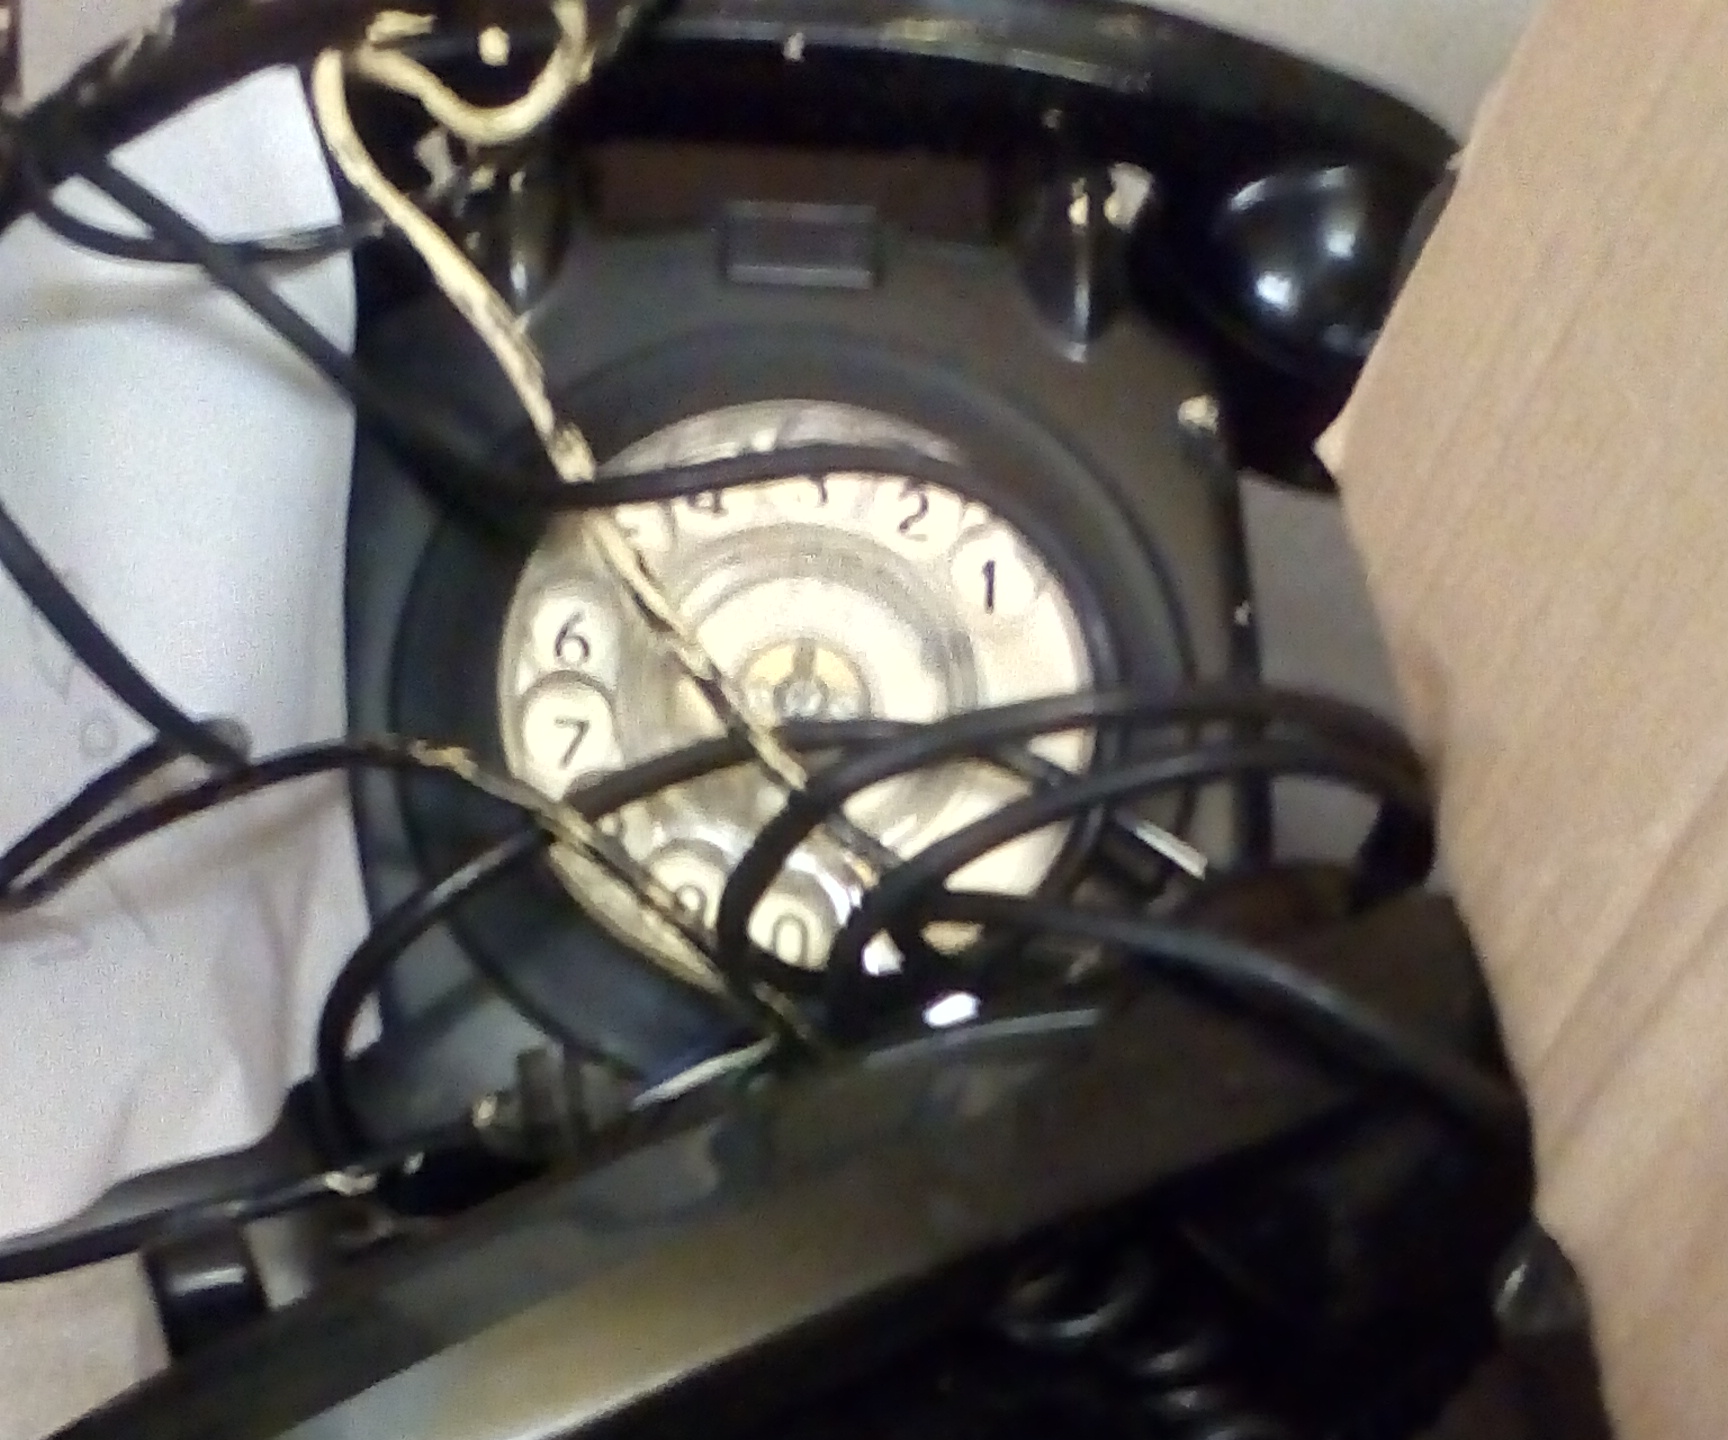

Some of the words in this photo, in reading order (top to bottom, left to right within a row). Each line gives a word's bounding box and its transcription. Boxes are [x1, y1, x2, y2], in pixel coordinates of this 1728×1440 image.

[980, 558, 997, 615] 1
[553, 611, 592, 667] 6
[553, 716, 592, 769] 7
